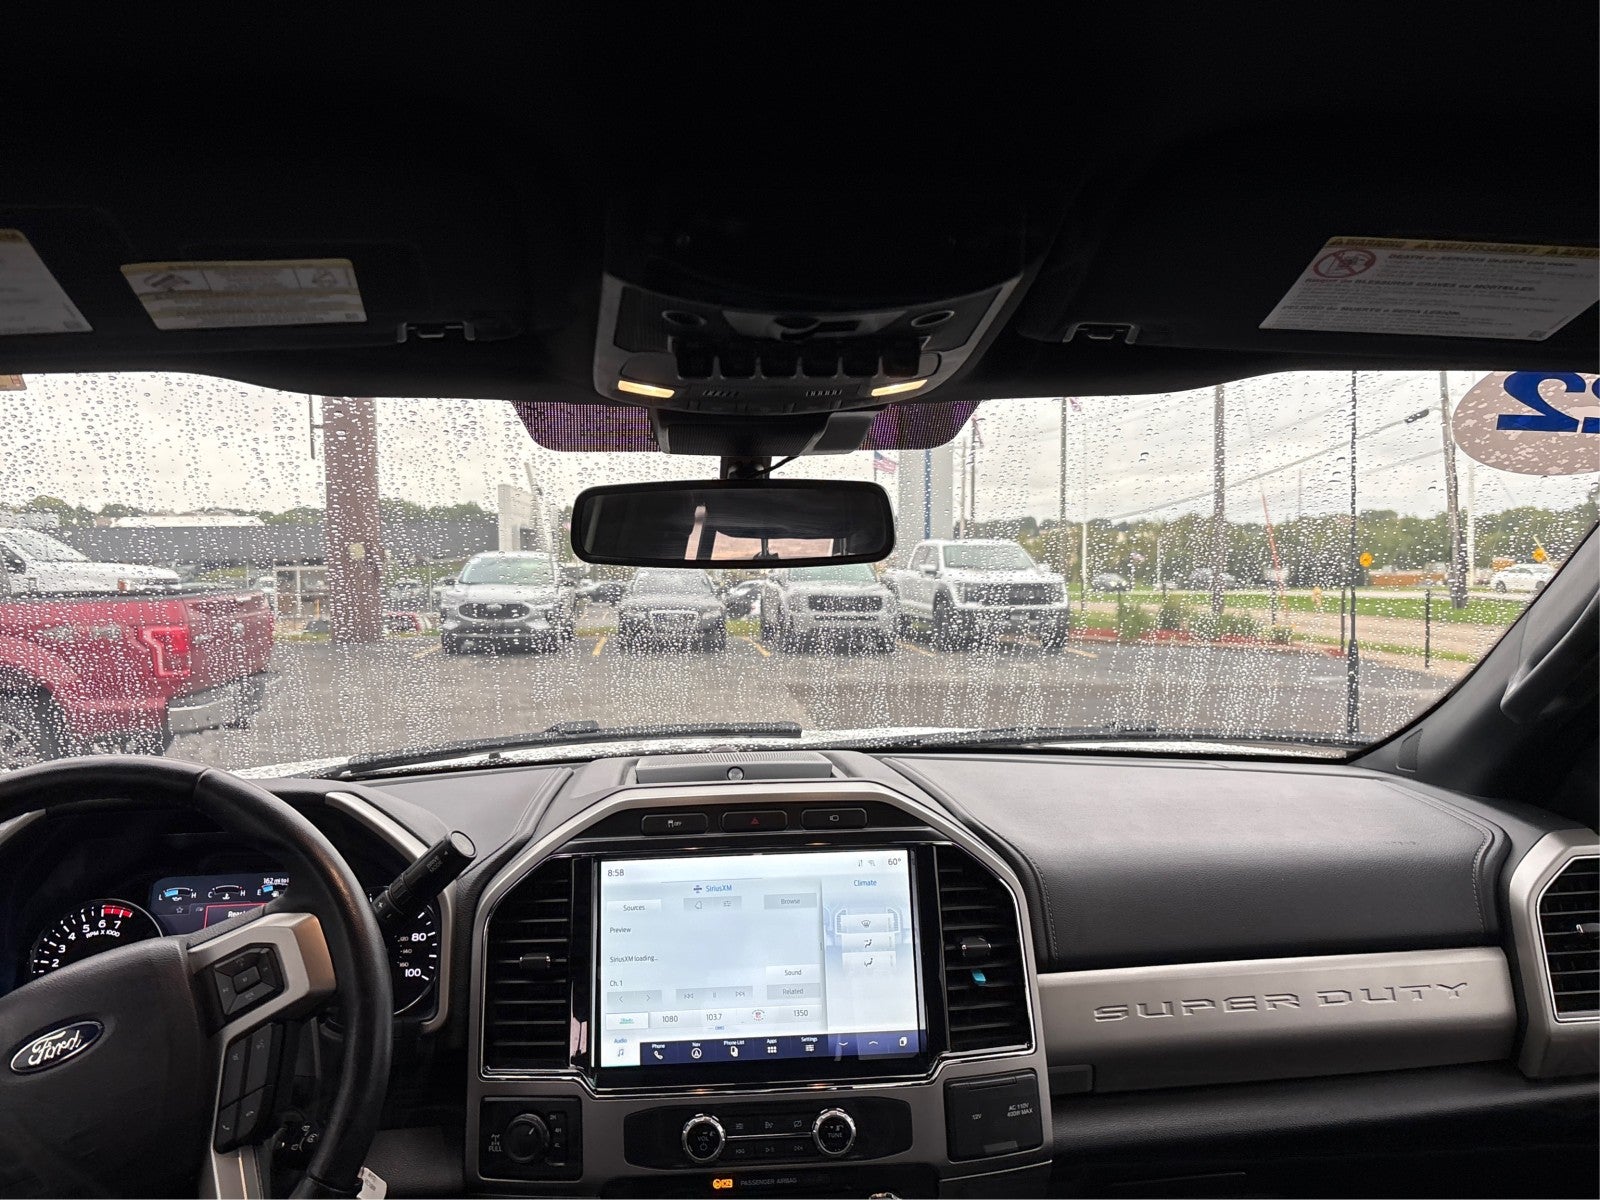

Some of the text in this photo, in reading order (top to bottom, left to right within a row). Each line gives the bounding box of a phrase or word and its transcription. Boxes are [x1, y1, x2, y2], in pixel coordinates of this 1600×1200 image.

[888, 858, 902, 866] 60°
[607, 868, 625, 877] 8:58
[853, 879, 877, 887] Climate
[705, 884, 732, 892] SiriusXM
[623, 904, 645, 912] Sources
[98, 920, 106, 928] 6
[114, 921, 121, 929] 7
[82, 924, 90, 933] 5
[609, 926, 631, 934] Preview
[68, 932, 76, 941] 4
[85, 931, 99, 939] RPM
[106, 929, 121, 937] 1000
[411, 933, 427, 942] 80
[58, 945, 66, 953] 3
[52, 959, 59, 967] 2
[610, 955, 634, 963] SiriusXM
[405, 968, 421, 977] 100
[609, 979, 619, 987] Ch.
[782, 987, 803, 995] Related
[1093, 982, 1468, 1023] SUPER DUTY
[706, 1013, 722, 1021] 103.7
[793, 1009, 809, 1017] 1350
[662, 1015, 679, 1023] 1080
[28, 1030, 82, 1065] Ford
